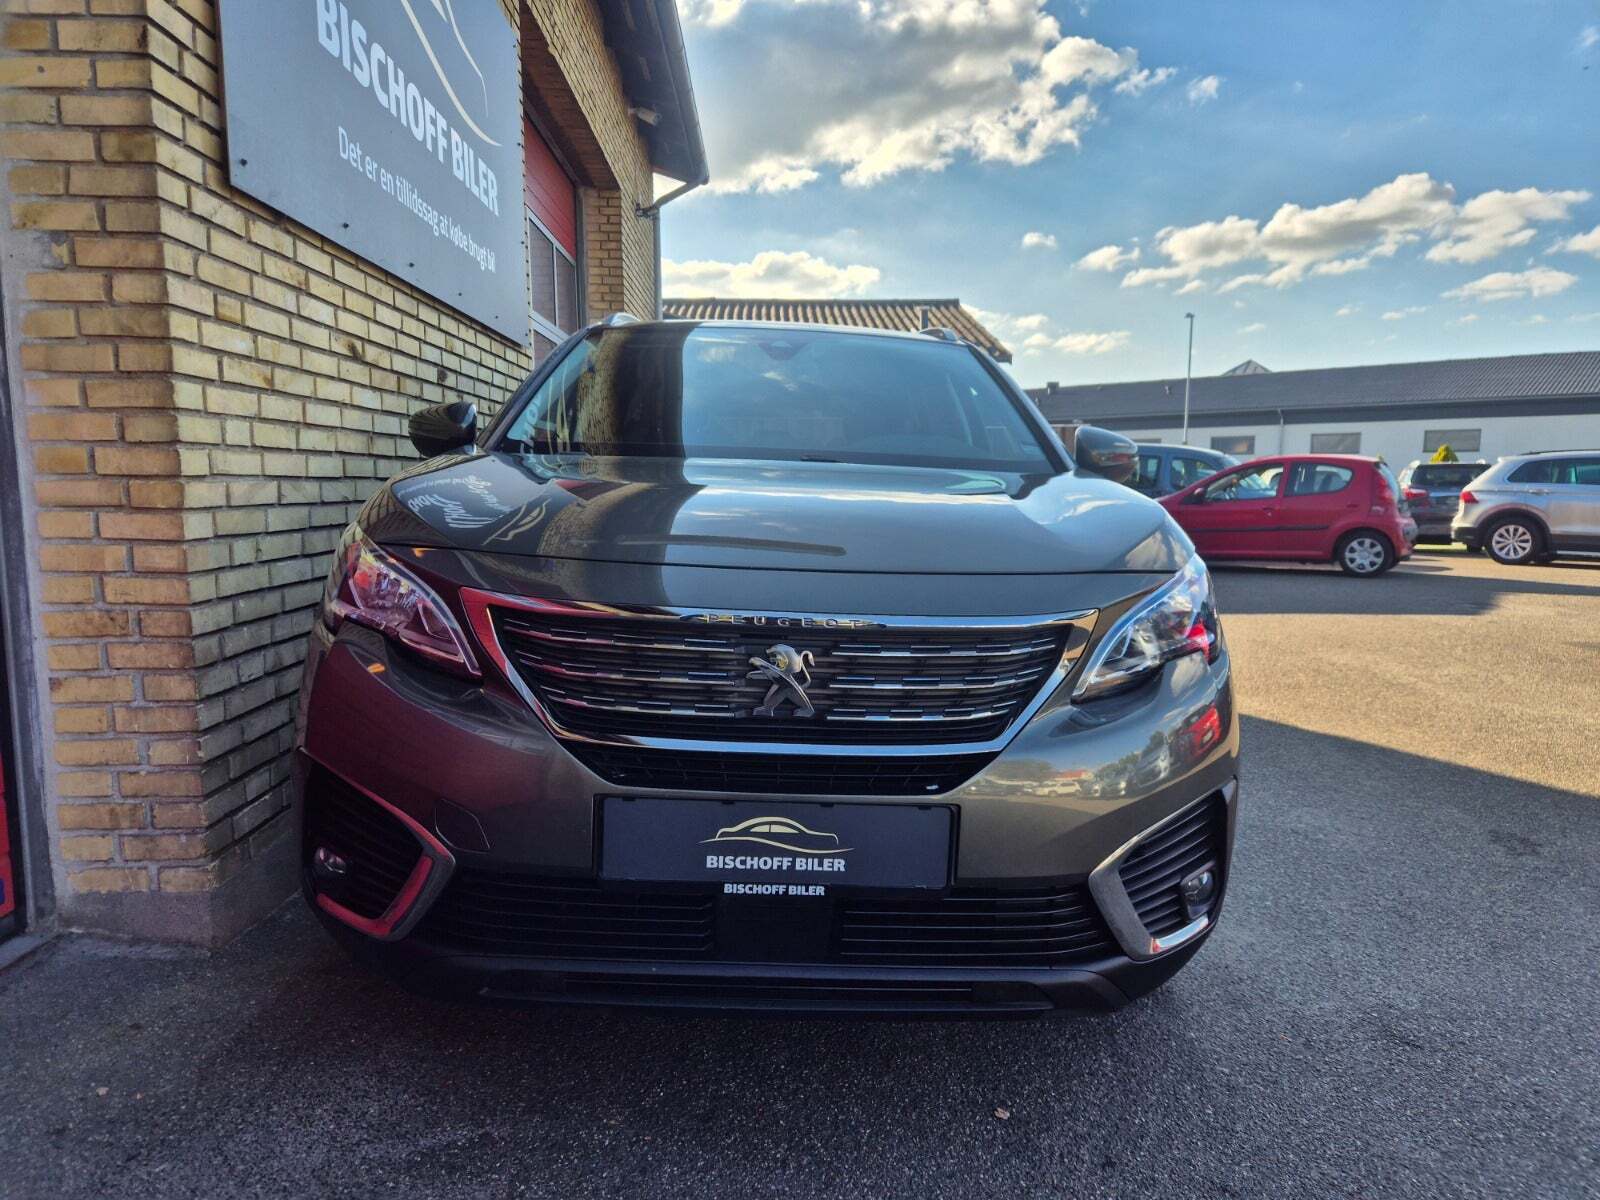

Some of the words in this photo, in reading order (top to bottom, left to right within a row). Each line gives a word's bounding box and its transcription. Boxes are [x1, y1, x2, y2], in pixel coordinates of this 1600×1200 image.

[316, 0, 448, 163] BISCHOFF
[451, 127, 499, 217] BILER
[338, 126, 363, 172] Det
[365, 156, 378, 182] er
[380, 167, 394, 196] en
[396, 175, 439, 237] tillidssag
[440, 215, 449, 238] at
[450, 216, 468, 252] købe
[469, 233, 487, 271] brugt
[487, 248, 496, 273] bil
[706, 614, 862, 630] PEUGEOT
[706, 855, 792, 871] BISCHOFF
[795, 857, 846, 872] BILER
[723, 883, 787, 895] BISCHOFF
[788, 885, 825, 896] BILER
